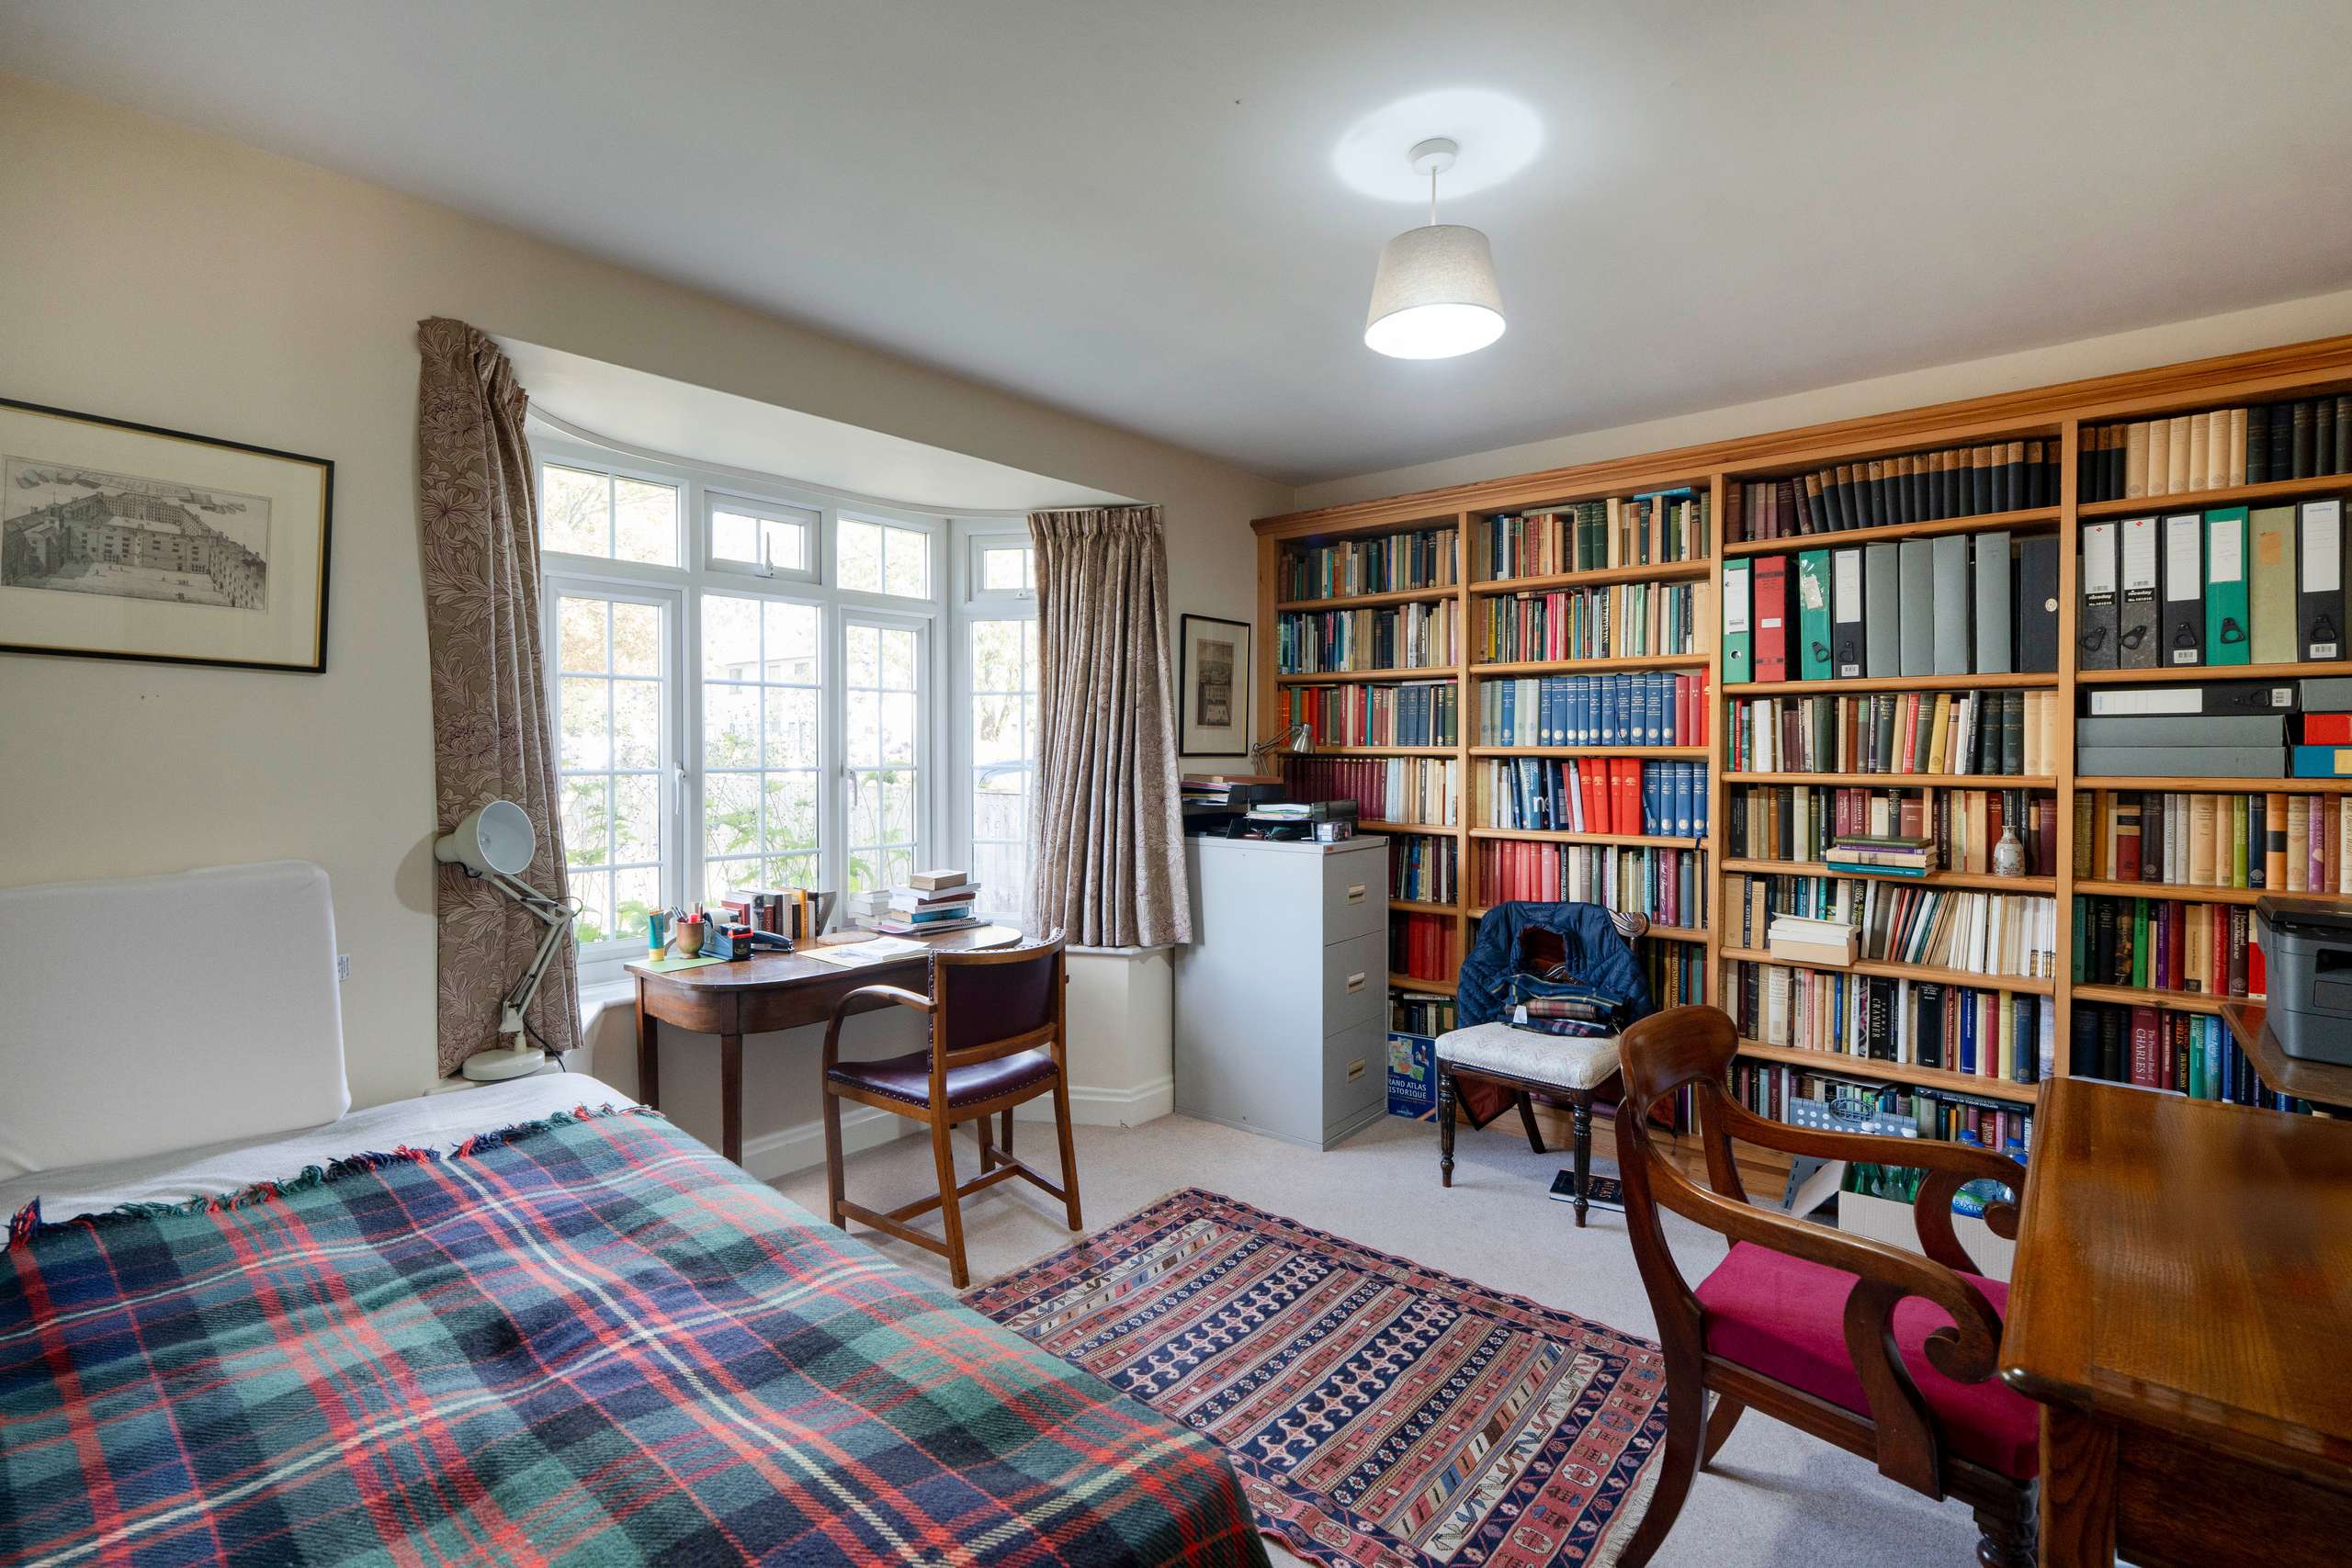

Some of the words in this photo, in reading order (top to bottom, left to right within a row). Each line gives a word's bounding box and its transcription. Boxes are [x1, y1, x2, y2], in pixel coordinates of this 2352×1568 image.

[1871, 998, 1881, 1038] CRANMER
[2136, 1028, 2146, 1073] CHARLES
[1388, 1086, 1427, 1100] ISTORIQUE
[1406, 1081, 1427, 1091] ATLAS
[1954, 1200, 1984, 1213] BUXTO
